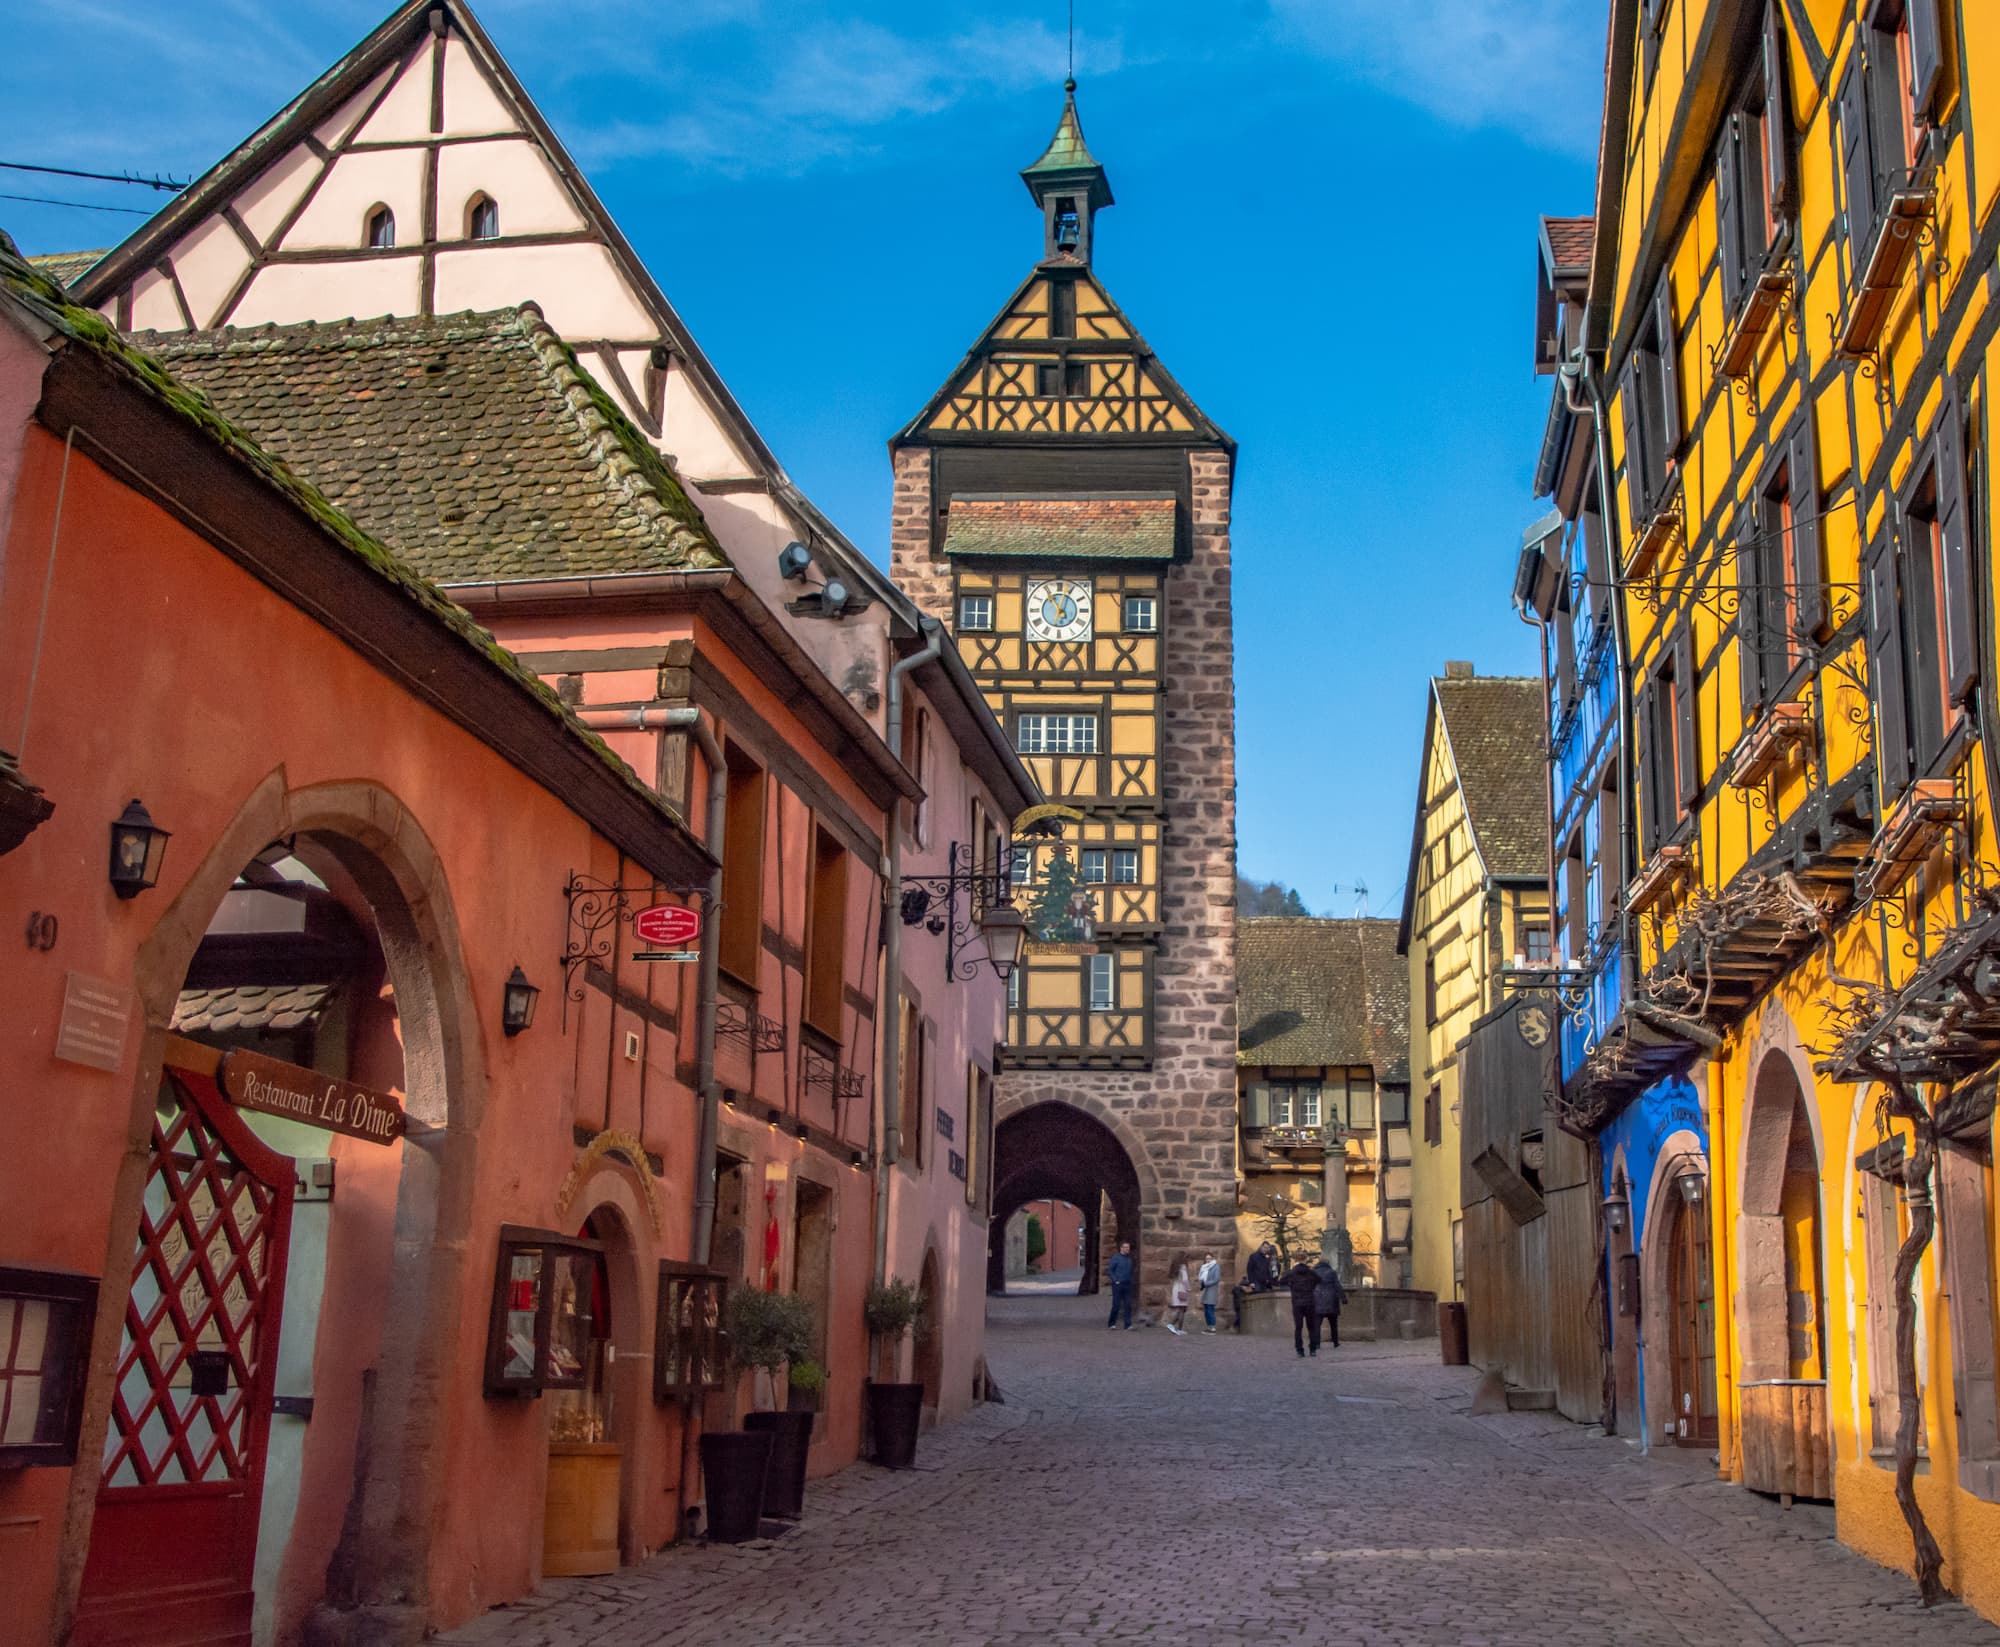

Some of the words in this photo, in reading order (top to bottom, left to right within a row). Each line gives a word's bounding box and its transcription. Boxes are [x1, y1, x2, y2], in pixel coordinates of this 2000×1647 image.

[243, 1071, 315, 1116] Restaurant
[319, 1084, 347, 1124] La
[350, 1092, 396, 1137] Dîme
